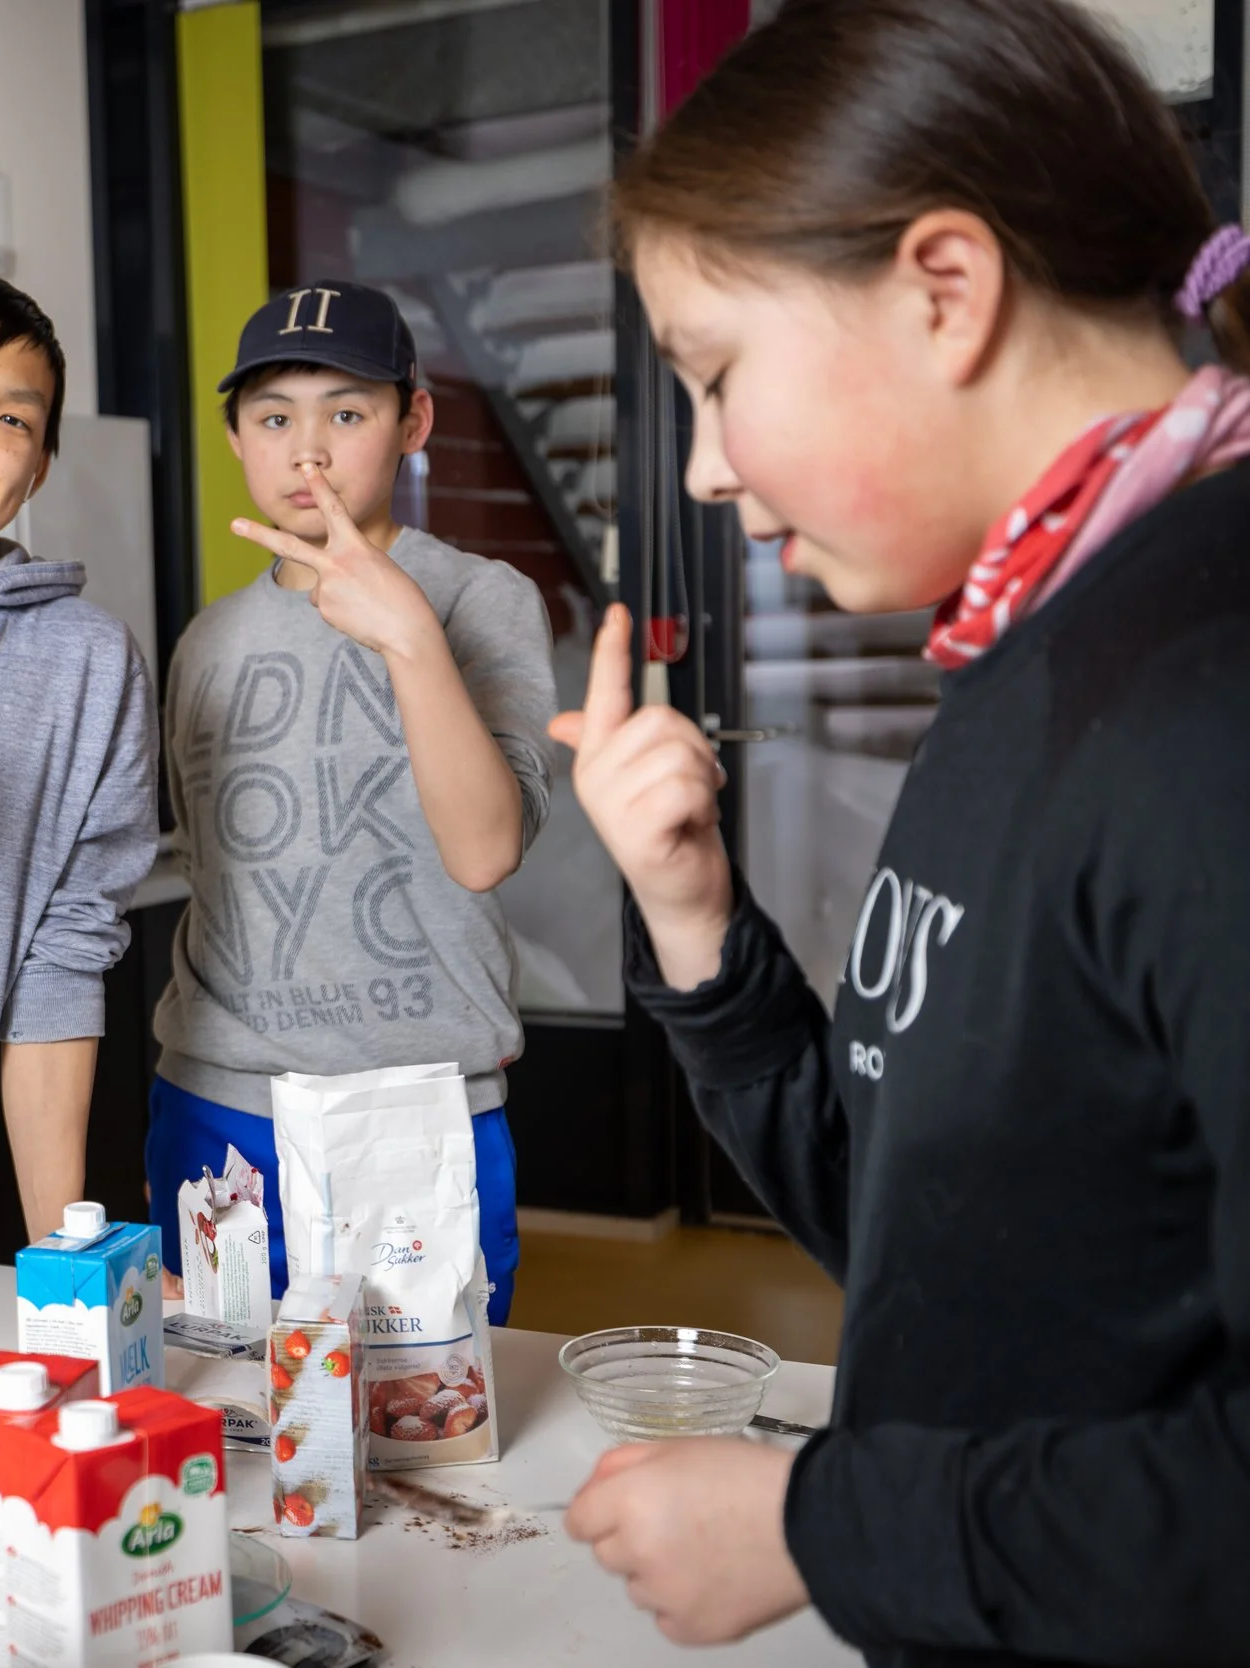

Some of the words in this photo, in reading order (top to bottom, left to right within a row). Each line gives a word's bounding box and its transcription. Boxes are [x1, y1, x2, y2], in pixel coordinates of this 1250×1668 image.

[278, 288, 341, 336] II
[367, 974, 434, 1022] 93
[277, 1003, 364, 1032] DENIM
[370, 1242, 411, 1266] Dan
[383, 1252, 427, 1271] Sukker
[121, 1300, 140, 1322] Arla
[168, 1322, 250, 1341] LURPAK
[129, 1521, 176, 1552] Arla
[89, 1585, 165, 1637] WHIPPING
[168, 1570, 223, 1610] CREAM
